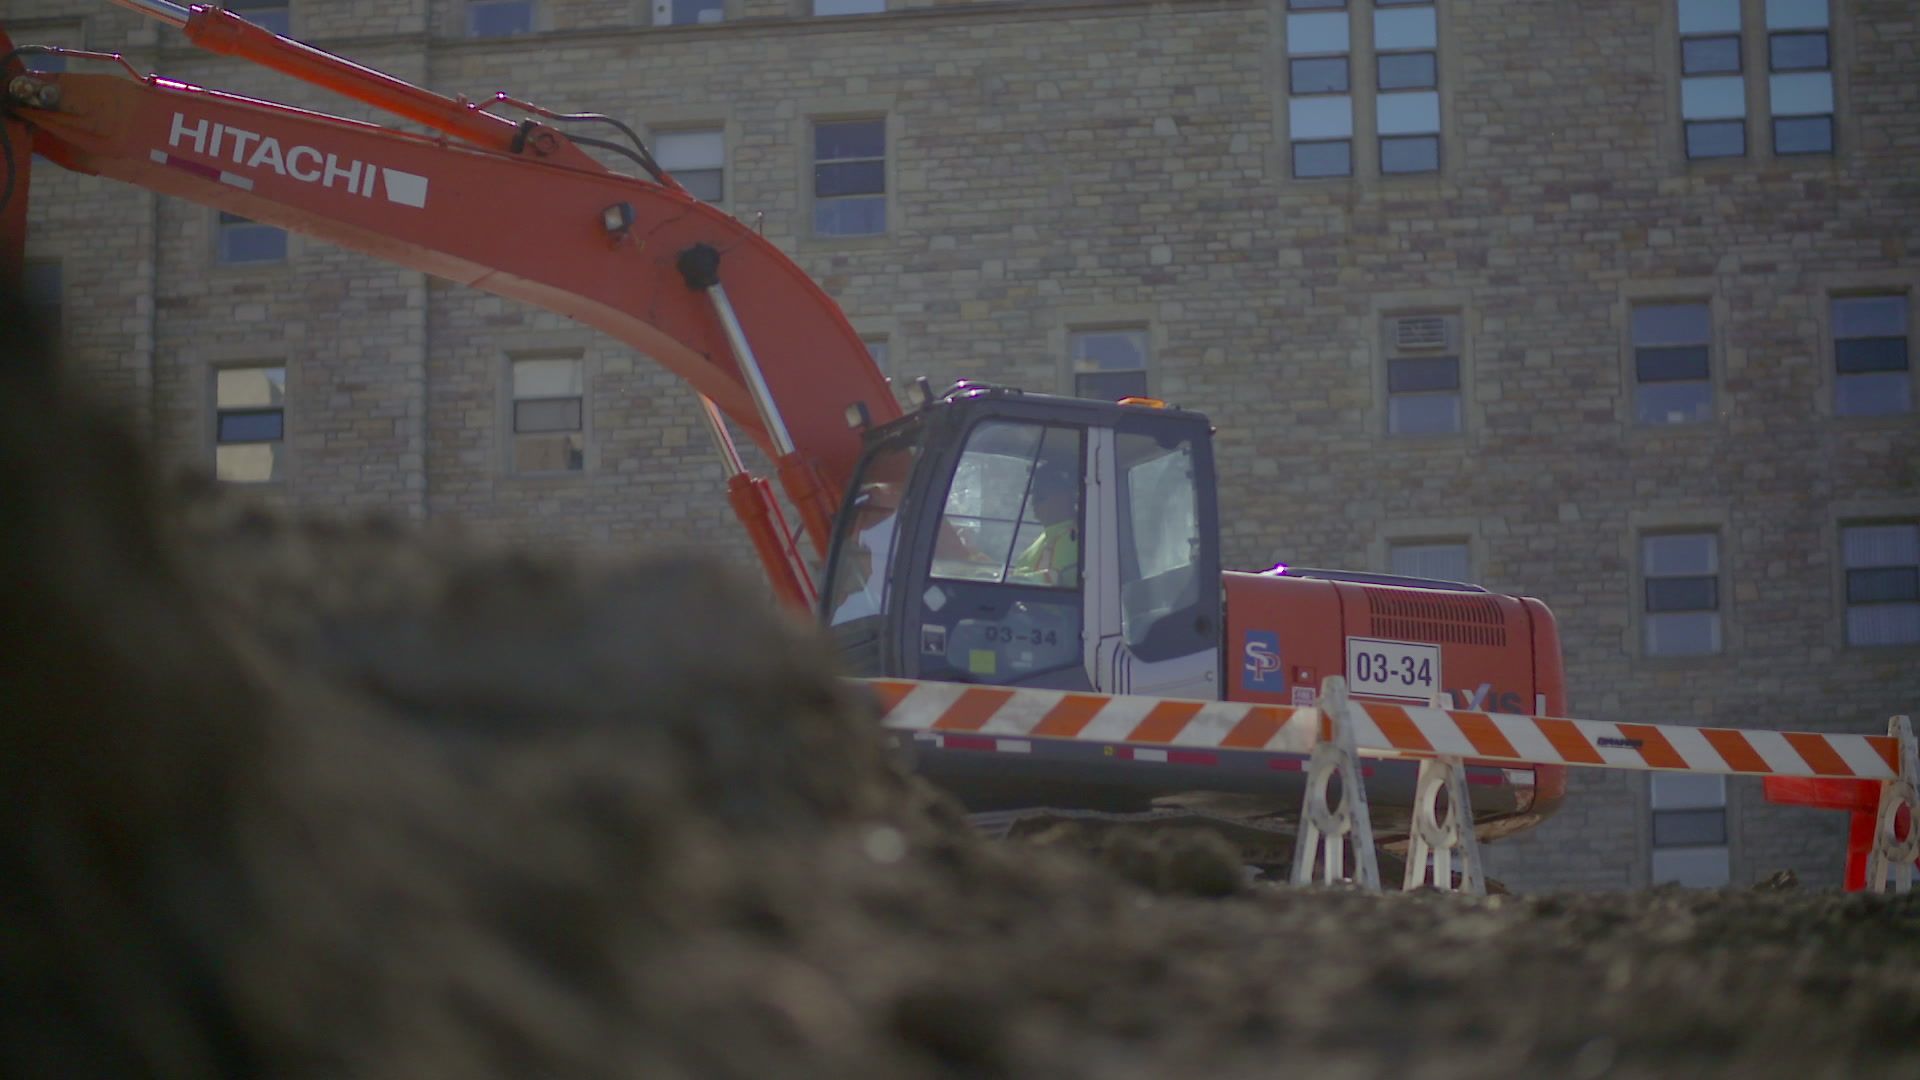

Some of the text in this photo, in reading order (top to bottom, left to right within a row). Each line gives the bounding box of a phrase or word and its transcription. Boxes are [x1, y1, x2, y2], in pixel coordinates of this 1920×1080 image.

[168, 112, 376, 198] HITACHI
[985, 626, 1057, 646] 03-34
[1356, 652, 1433, 687] 03-34
